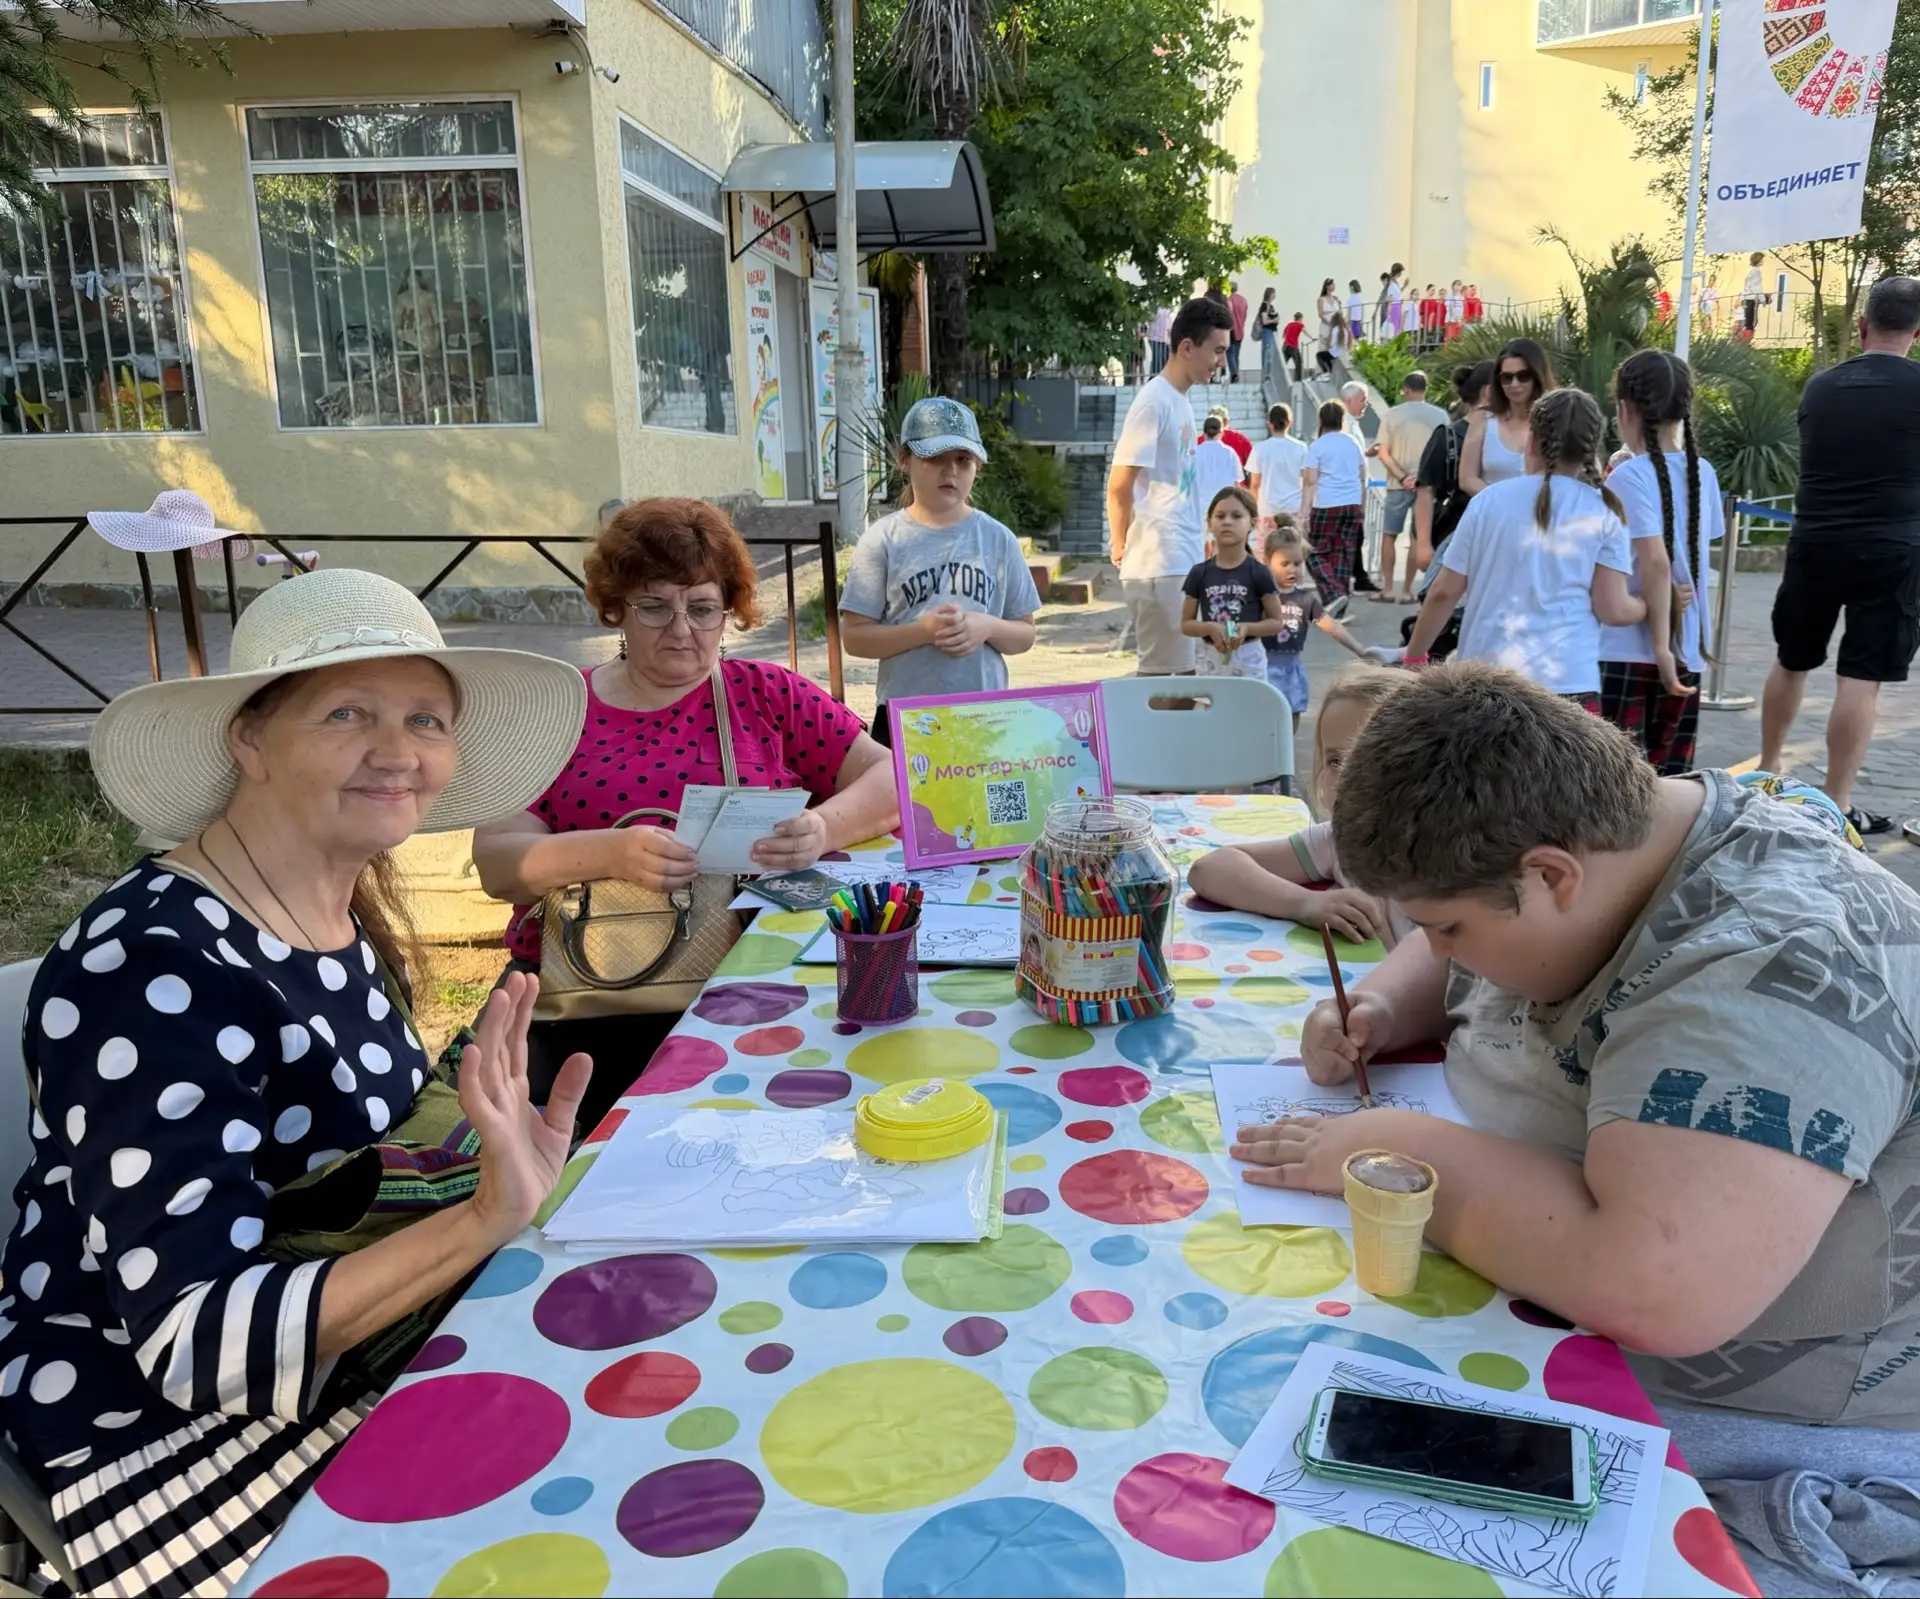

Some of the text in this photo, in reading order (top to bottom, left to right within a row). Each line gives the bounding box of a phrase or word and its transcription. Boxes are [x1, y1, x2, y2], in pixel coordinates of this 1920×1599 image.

[1717, 162, 1861, 201] ОБЪЕДИНЯЕТ
[935, 754, 1077, 782] Мастер-класс
[1851, 1345, 1920, 1397] WORRY
